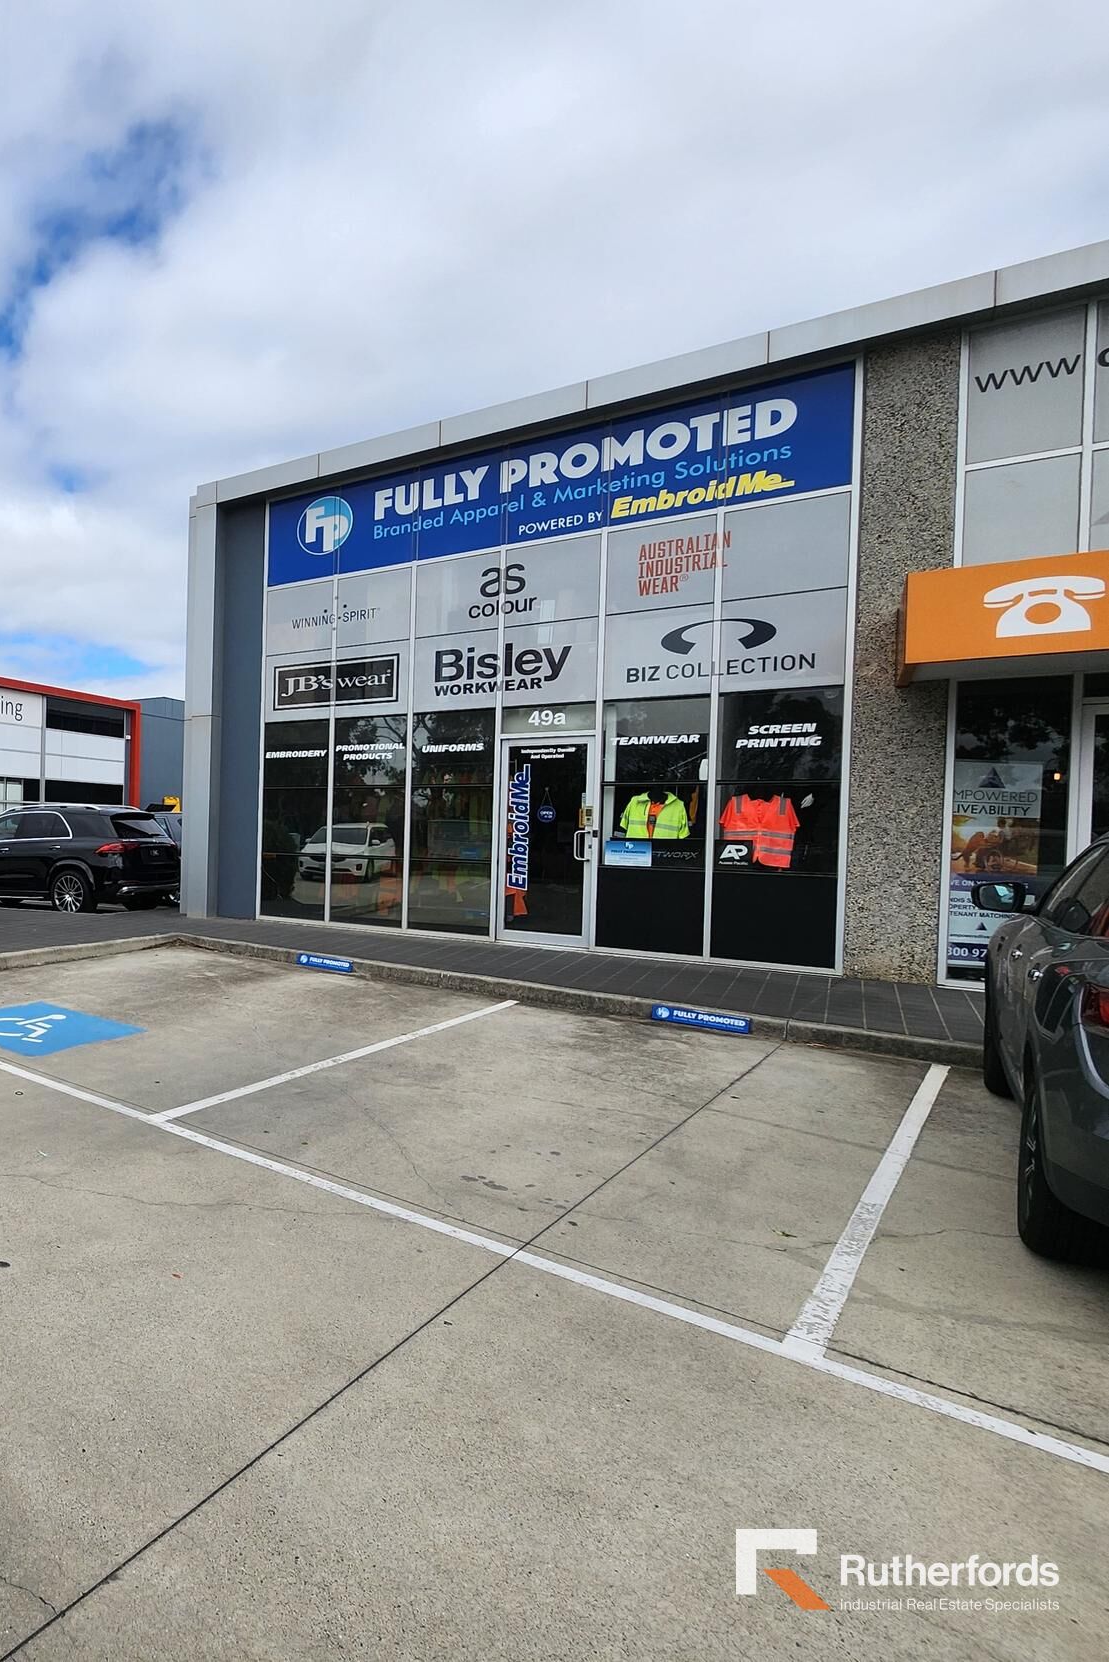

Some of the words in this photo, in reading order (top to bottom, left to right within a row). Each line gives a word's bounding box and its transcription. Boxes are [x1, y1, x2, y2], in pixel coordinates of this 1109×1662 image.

[373, 464, 489, 521] FULLY
[499, 398, 798, 494] PROMOTED
[373, 511, 443, 540] Branded
[450, 494, 524, 526] Apparel
[531, 491, 547, 507] &
[553, 470, 665, 504] Marketing
[674, 445, 792, 480] Solutions
[518, 514, 583, 535] POWERED
[587, 511, 603, 523] BY
[639, 531, 731, 561] AUSTRALIAN
[468, 596, 537, 619] colour
[434, 642, 572, 682] Bisley
[626, 665, 660, 683] BIZ
[666, 653, 815, 680] COLLECTION
[281, 675, 333, 697] JB's
[434, 677, 542, 697] WORKWEAR
[528, 710, 566, 726] 49a
[748, 723, 817, 735] SCREEN
[335, 743, 405, 752] PROMOTIONAL
[422, 743, 484, 753] UNIFORMS
[611, 735, 700, 746] TEAMWEAR
[736, 736, 822, 748] PRINTING
[266, 750, 327, 759] EMBROIDERY
[343, 752, 393, 761] PRODUCTS
[954, 790, 1038, 803] MPOWERED
[953, 803, 1031, 817] IVEABILITY
[673, 1010, 697, 1019] FULLY
[698, 1014, 746, 1027] PROMOTED
